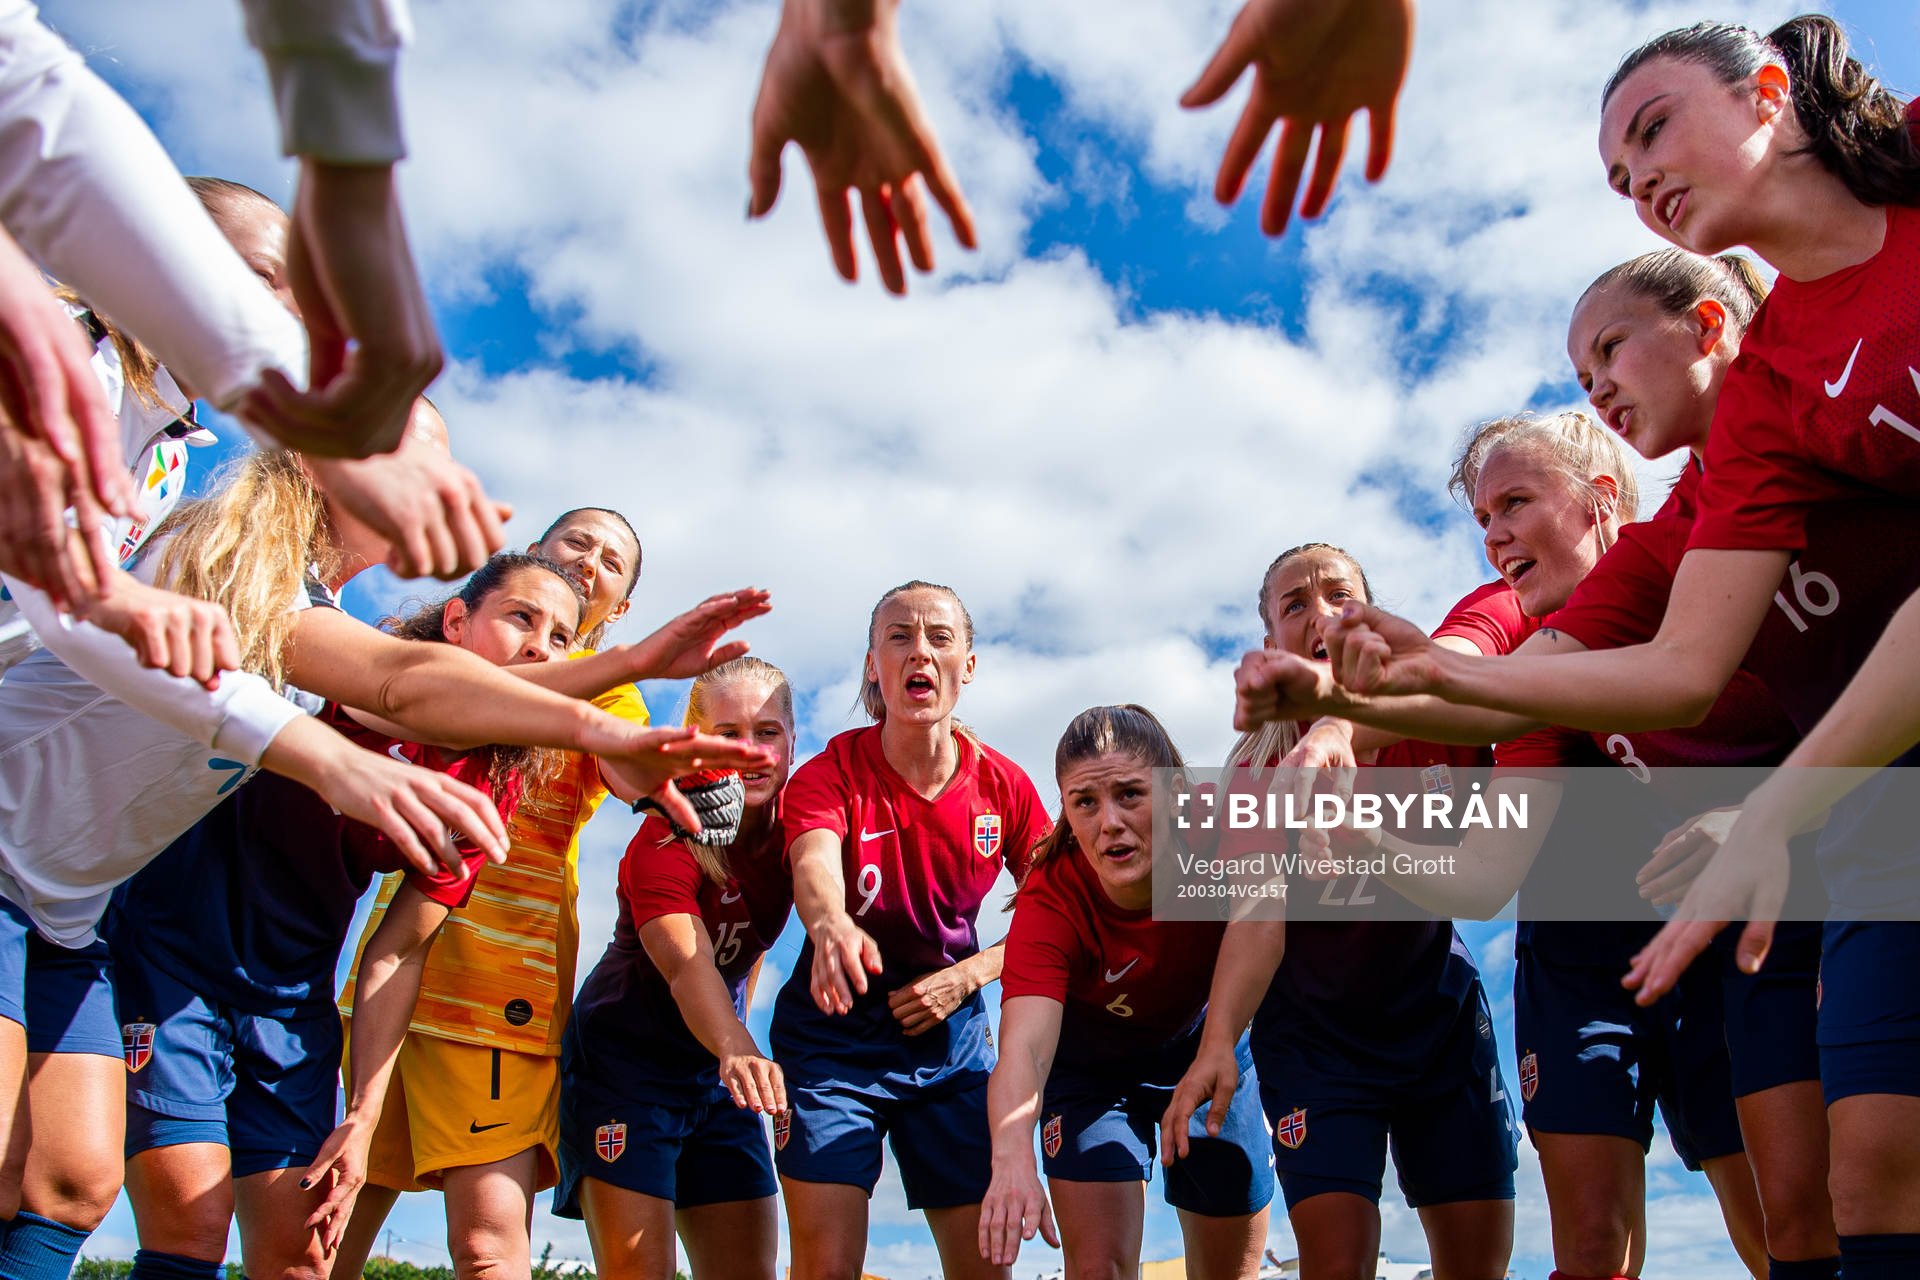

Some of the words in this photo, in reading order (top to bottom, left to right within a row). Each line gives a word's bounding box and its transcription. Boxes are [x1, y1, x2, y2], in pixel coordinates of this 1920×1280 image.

[1868, 365, 1920, 443] 1
[1774, 560, 1840, 632] 16
[1606, 733, 1651, 784] 3
[856, 863, 883, 917] 9
[713, 921, 750, 966] 15
[1106, 993, 1134, 1017] 6
